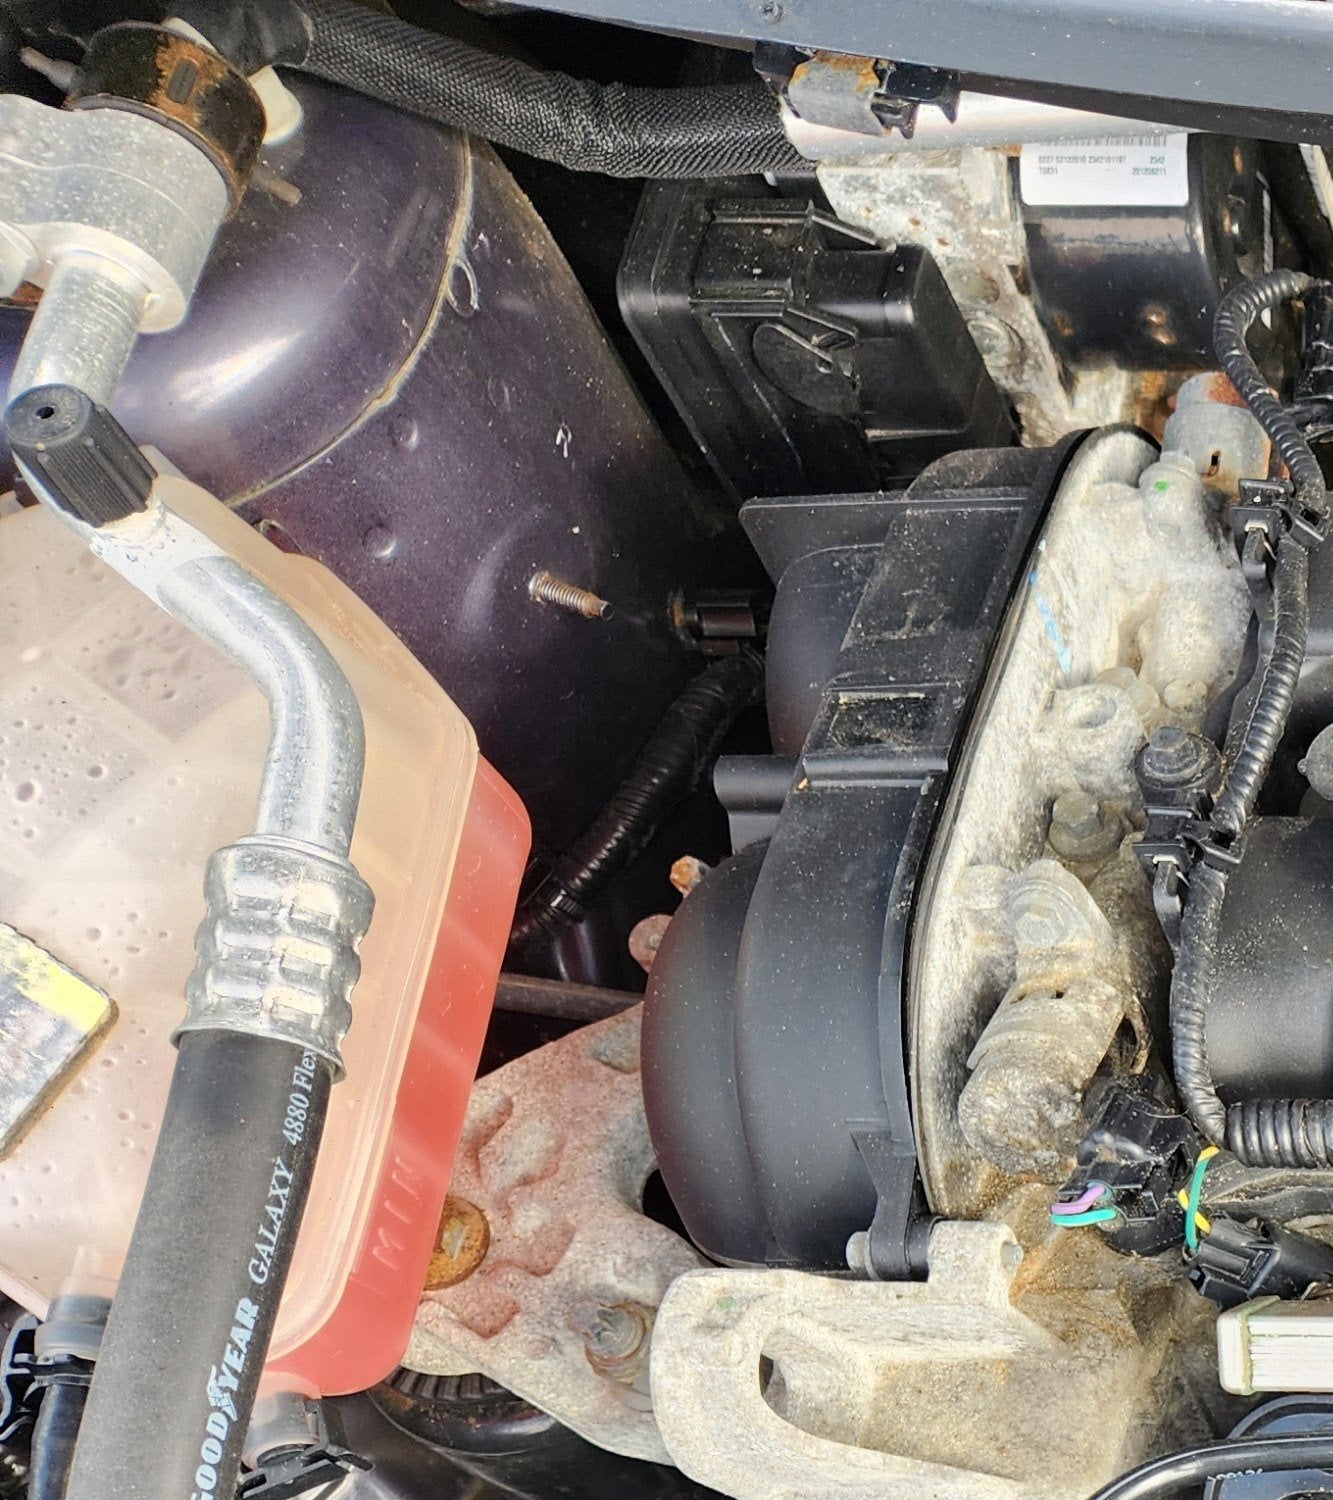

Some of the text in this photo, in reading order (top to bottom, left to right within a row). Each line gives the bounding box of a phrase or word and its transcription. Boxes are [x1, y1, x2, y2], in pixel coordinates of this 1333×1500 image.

[248, 1156, 295, 1286] GALAXY
[282, 1091, 311, 1147] 4880
[371, 1155, 424, 1271] MIN
